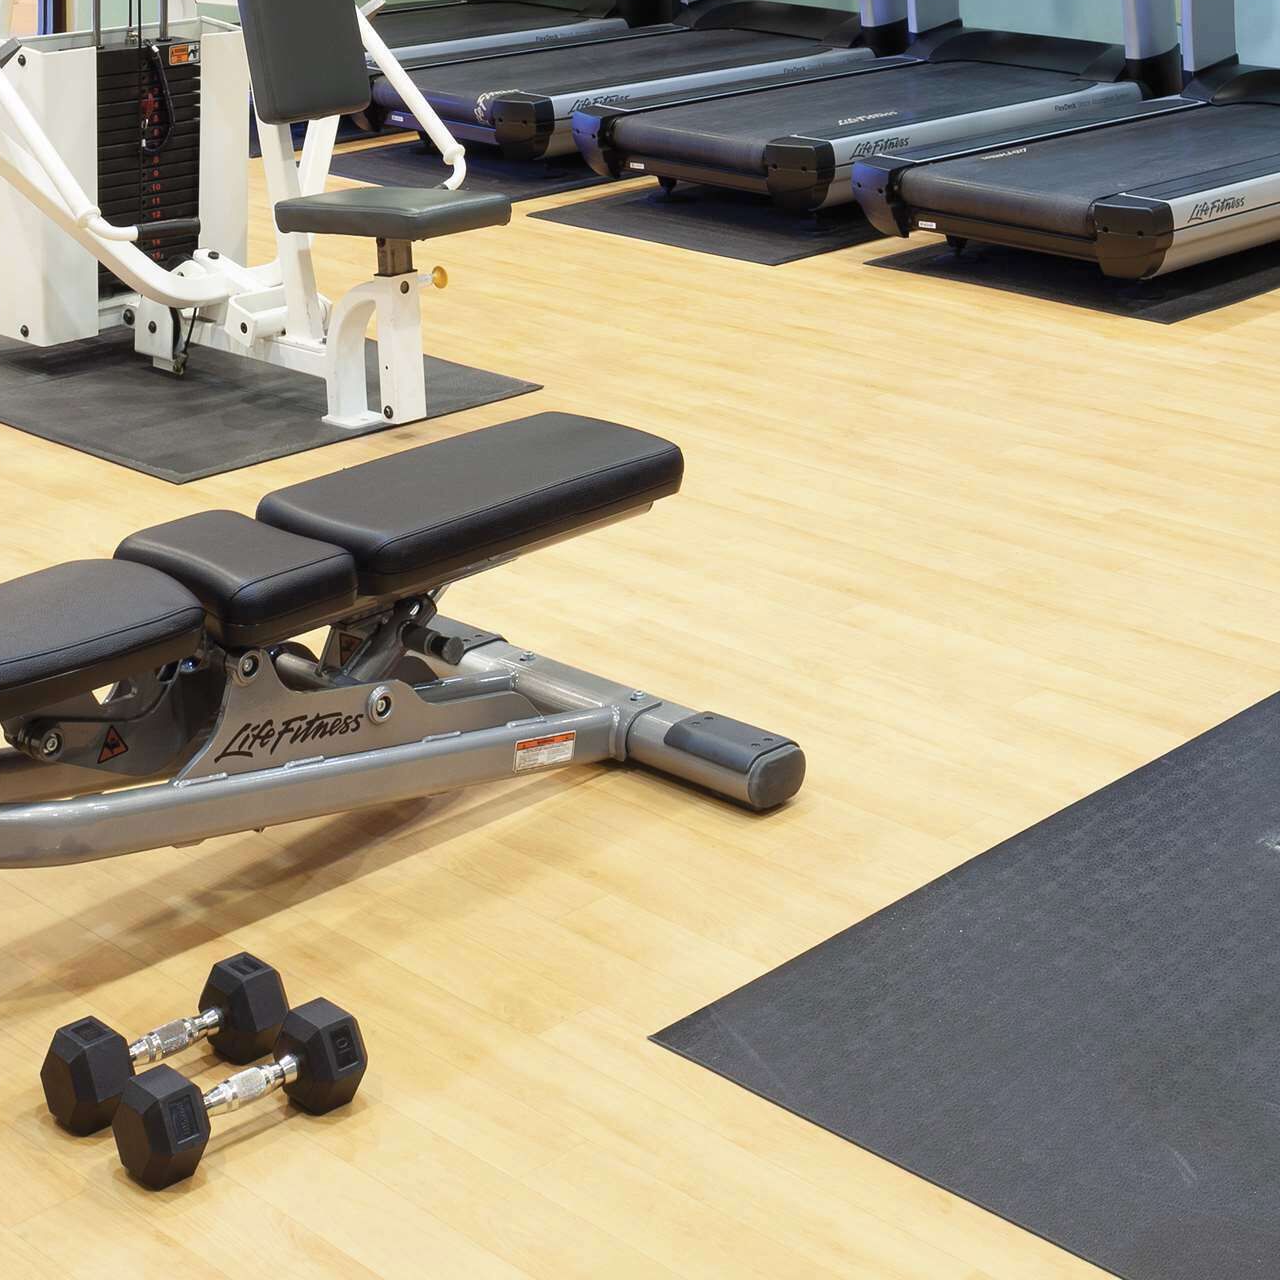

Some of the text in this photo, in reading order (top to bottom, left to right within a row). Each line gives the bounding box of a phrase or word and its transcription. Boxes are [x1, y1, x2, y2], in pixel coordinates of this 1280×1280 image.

[849, 136, 912, 160] LifeFitness
[1187, 196, 1247, 223] LifeFitness
[214, 711, 364, 763] LifeFitness
